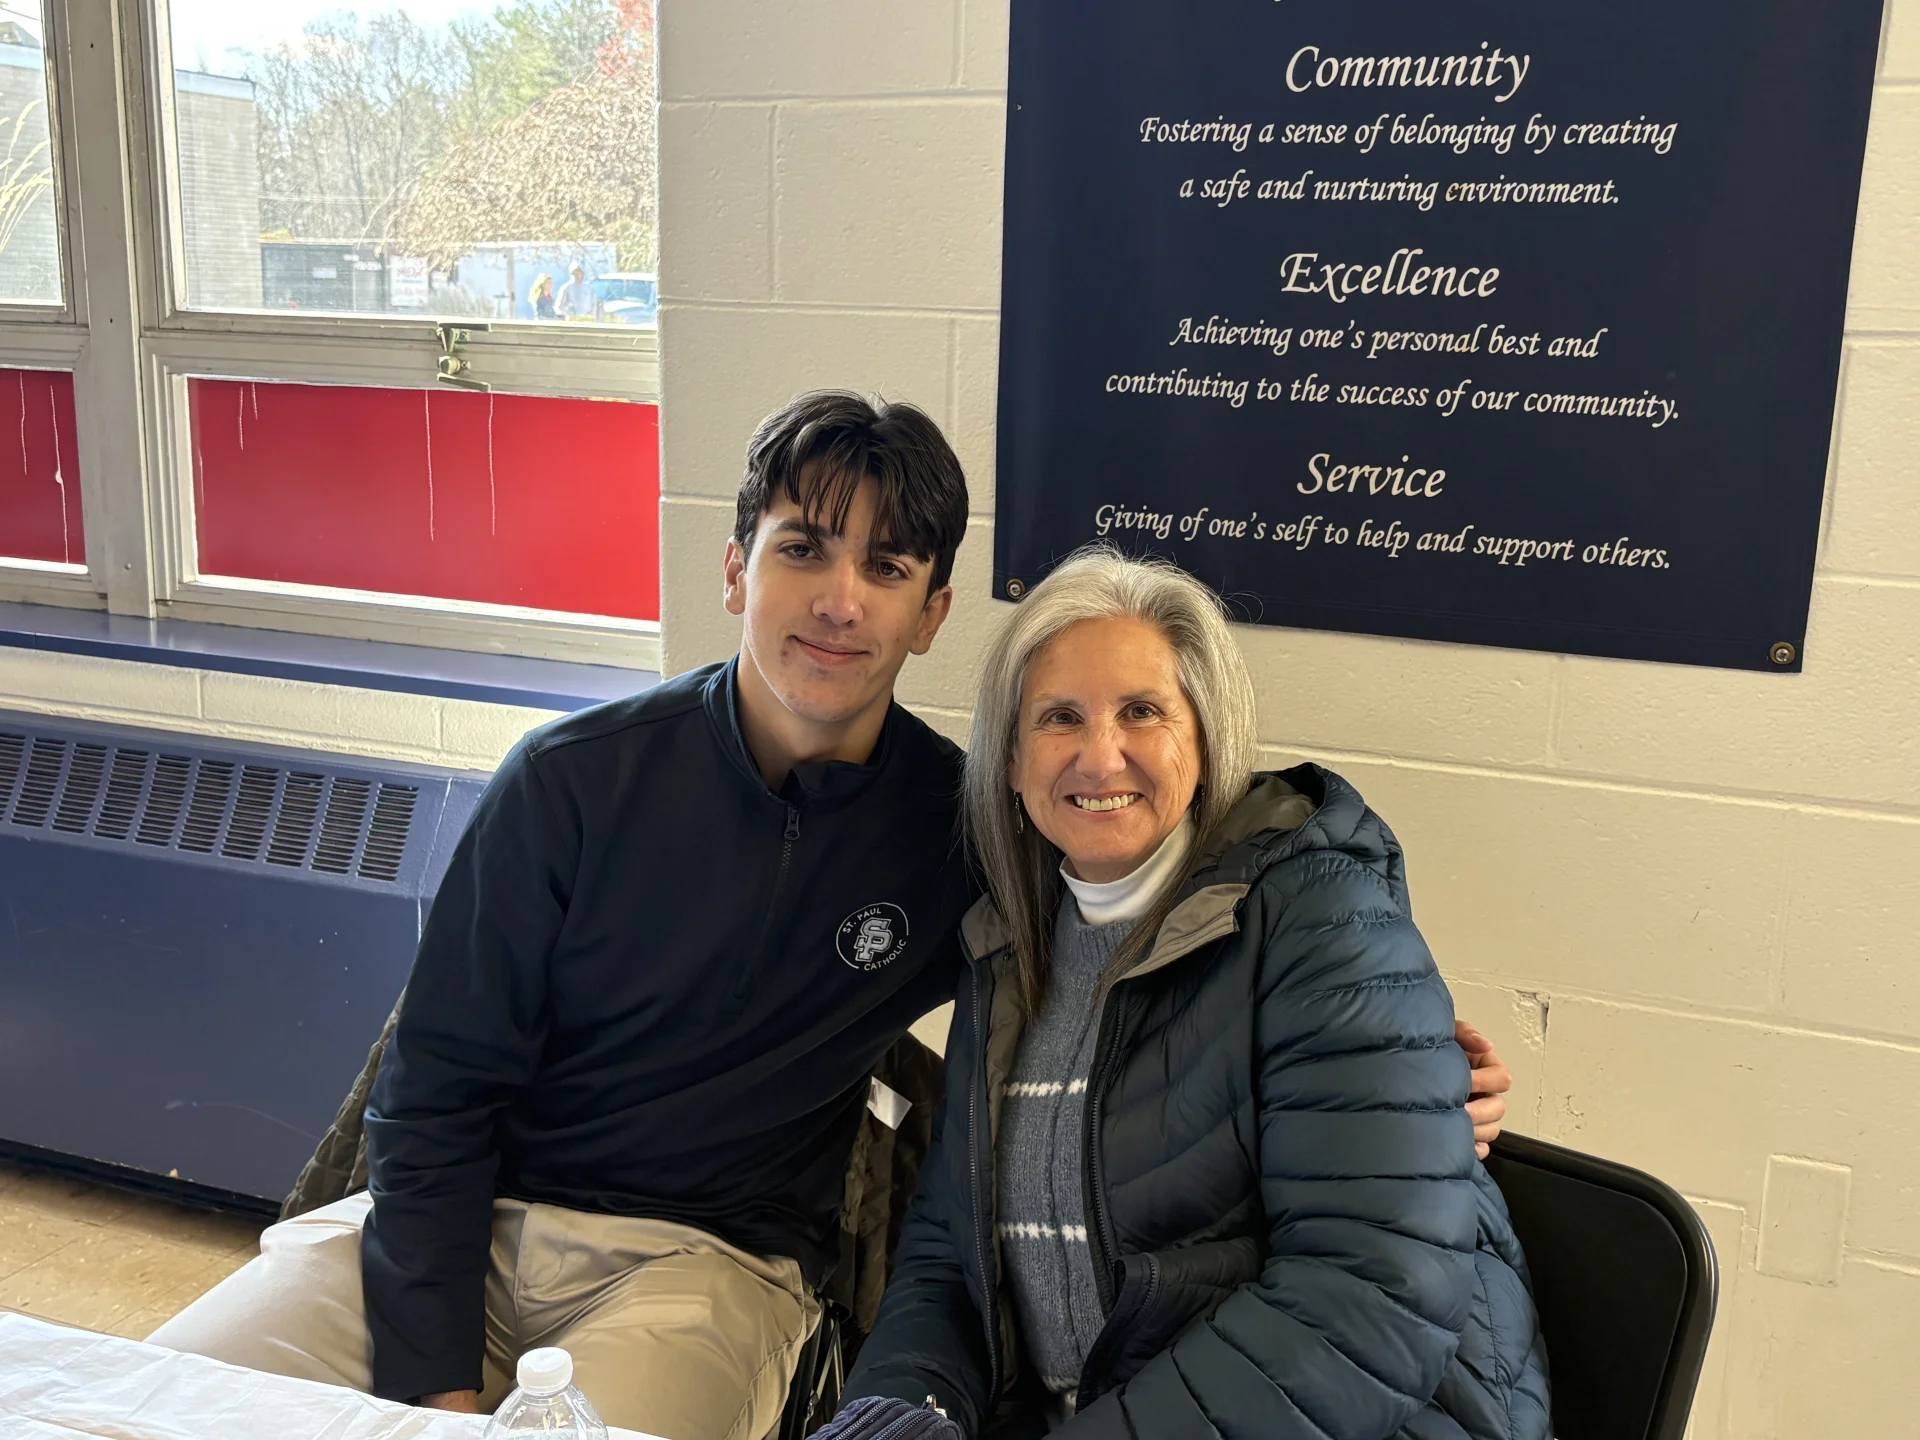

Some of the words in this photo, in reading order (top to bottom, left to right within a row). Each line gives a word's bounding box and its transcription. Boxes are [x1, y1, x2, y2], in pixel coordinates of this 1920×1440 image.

[1286, 41, 1530, 102] Community
[1140, 115, 1252, 152] Fostering
[1259, 124, 1274, 143] a
[1281, 124, 1347, 144] sense
[1355, 114, 1389, 153] of
[1390, 114, 1516, 154] belonging
[1524, 113, 1556, 154] by
[1563, 115, 1678, 155] creating
[1180, 179, 1194, 198] a
[1200, 169, 1250, 207] safe
[1257, 170, 1313, 200] and
[1314, 174, 1439, 211] nurturing
[1446, 175, 1620, 204] environment.
[1280, 248, 1499, 303] Excellence
[1169, 315, 1293, 355] Achieving
[1367, 324, 1488, 358] personal
[1488, 324, 1541, 355] best
[1548, 328, 1608, 357] and
[1106, 368, 1249, 408] contributing
[1257, 378, 1281, 400] to
[1291, 373, 1330, 402] the
[1337, 385, 1429, 407] success
[1436, 379, 1472, 417] of
[1472, 391, 1519, 411] our
[1524, 390, 1679, 428] community.
[1297, 454, 1445, 497] Service
[1096, 505, 1173, 539] Giving
[1180, 508, 1208, 541] of
[1272, 515, 1323, 550] self
[1325, 523, 1348, 544] to
[1357, 519, 1409, 557] help
[1417, 525, 1474, 555] and
[1474, 536, 1575, 567] support
[1583, 537, 1670, 569] others.
[857, 907, 881, 920] PAUL
[864, 939, 907, 971] CATHOLIC
